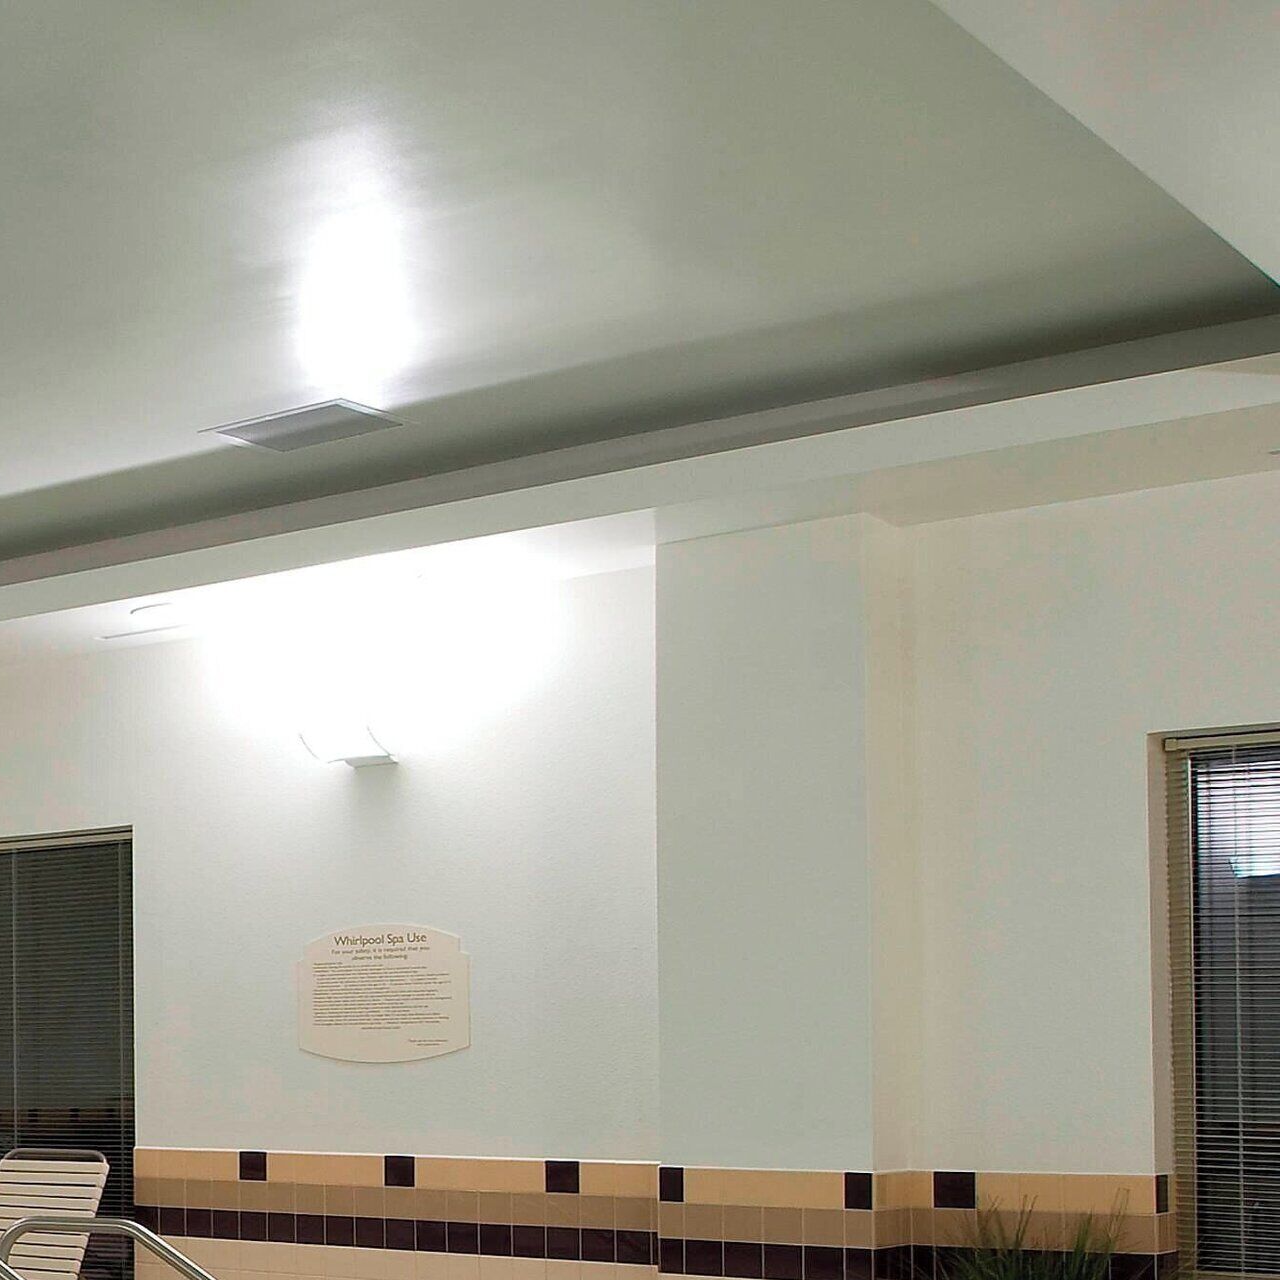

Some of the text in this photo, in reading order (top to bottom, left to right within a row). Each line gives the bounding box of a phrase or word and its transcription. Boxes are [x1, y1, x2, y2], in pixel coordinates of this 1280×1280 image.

[334, 932, 427, 947] Whirlpool Spa Use
